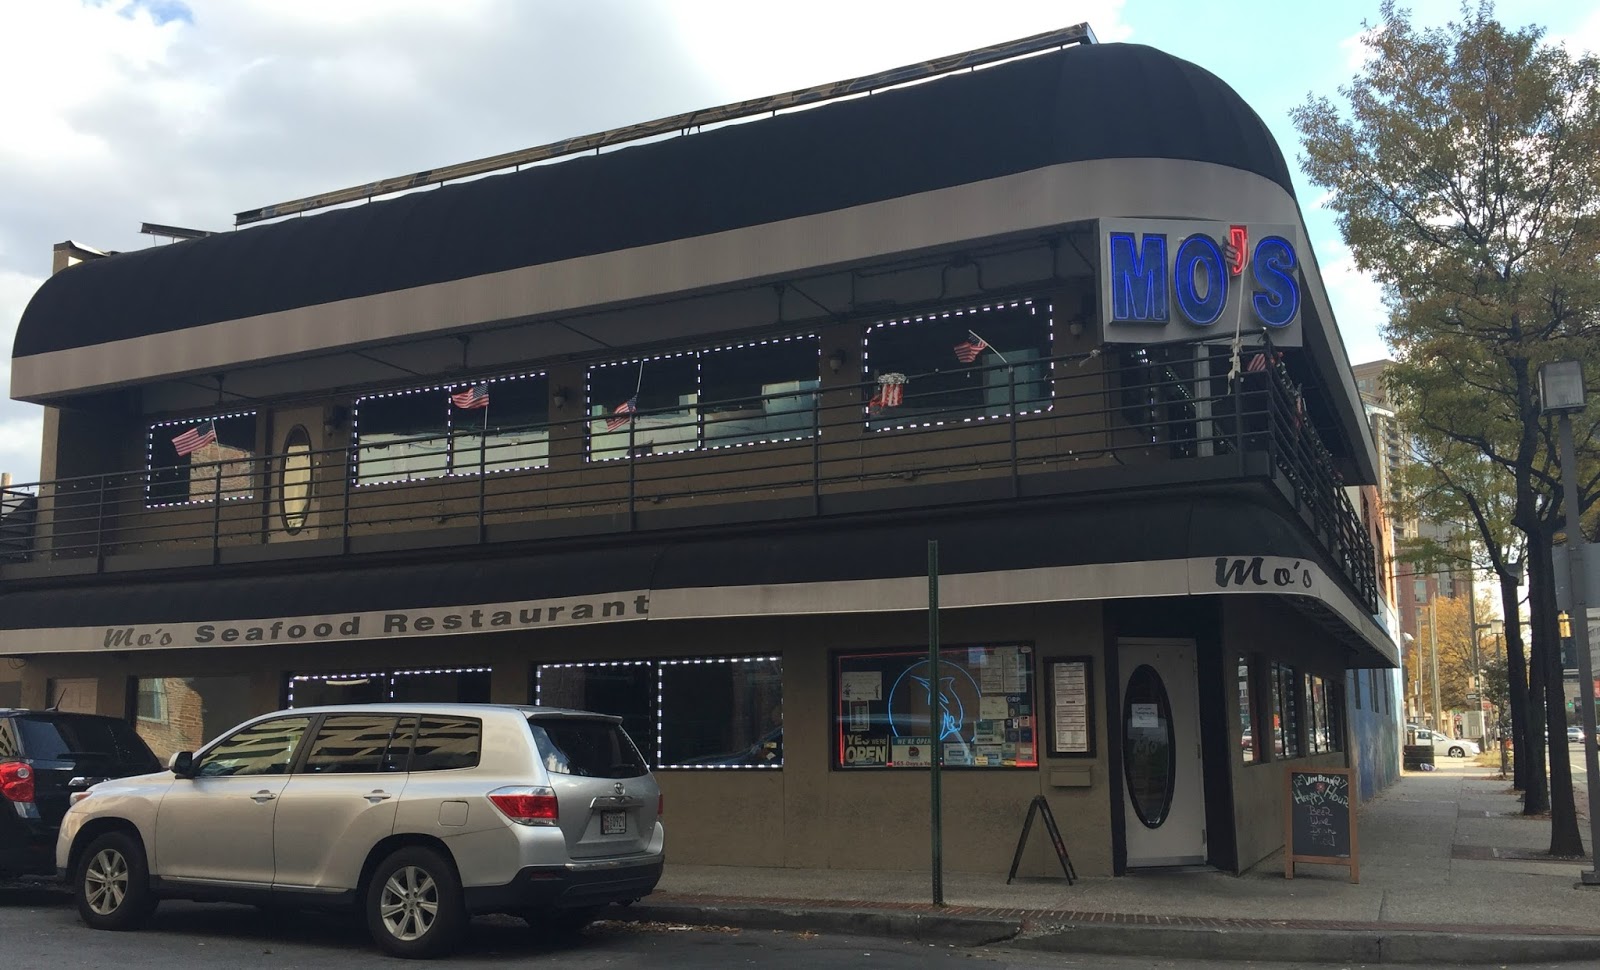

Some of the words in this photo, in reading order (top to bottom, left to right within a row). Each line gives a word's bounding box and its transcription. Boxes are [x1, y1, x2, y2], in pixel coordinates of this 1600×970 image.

[1109, 225, 1301, 328] MO'S
[1215, 557, 1312, 588] Mo's
[103, 627, 173, 648] Mo's
[194, 616, 361, 643] Seafood
[383, 595, 650, 633] Restaurant
[845, 746, 886, 763] OPEN
